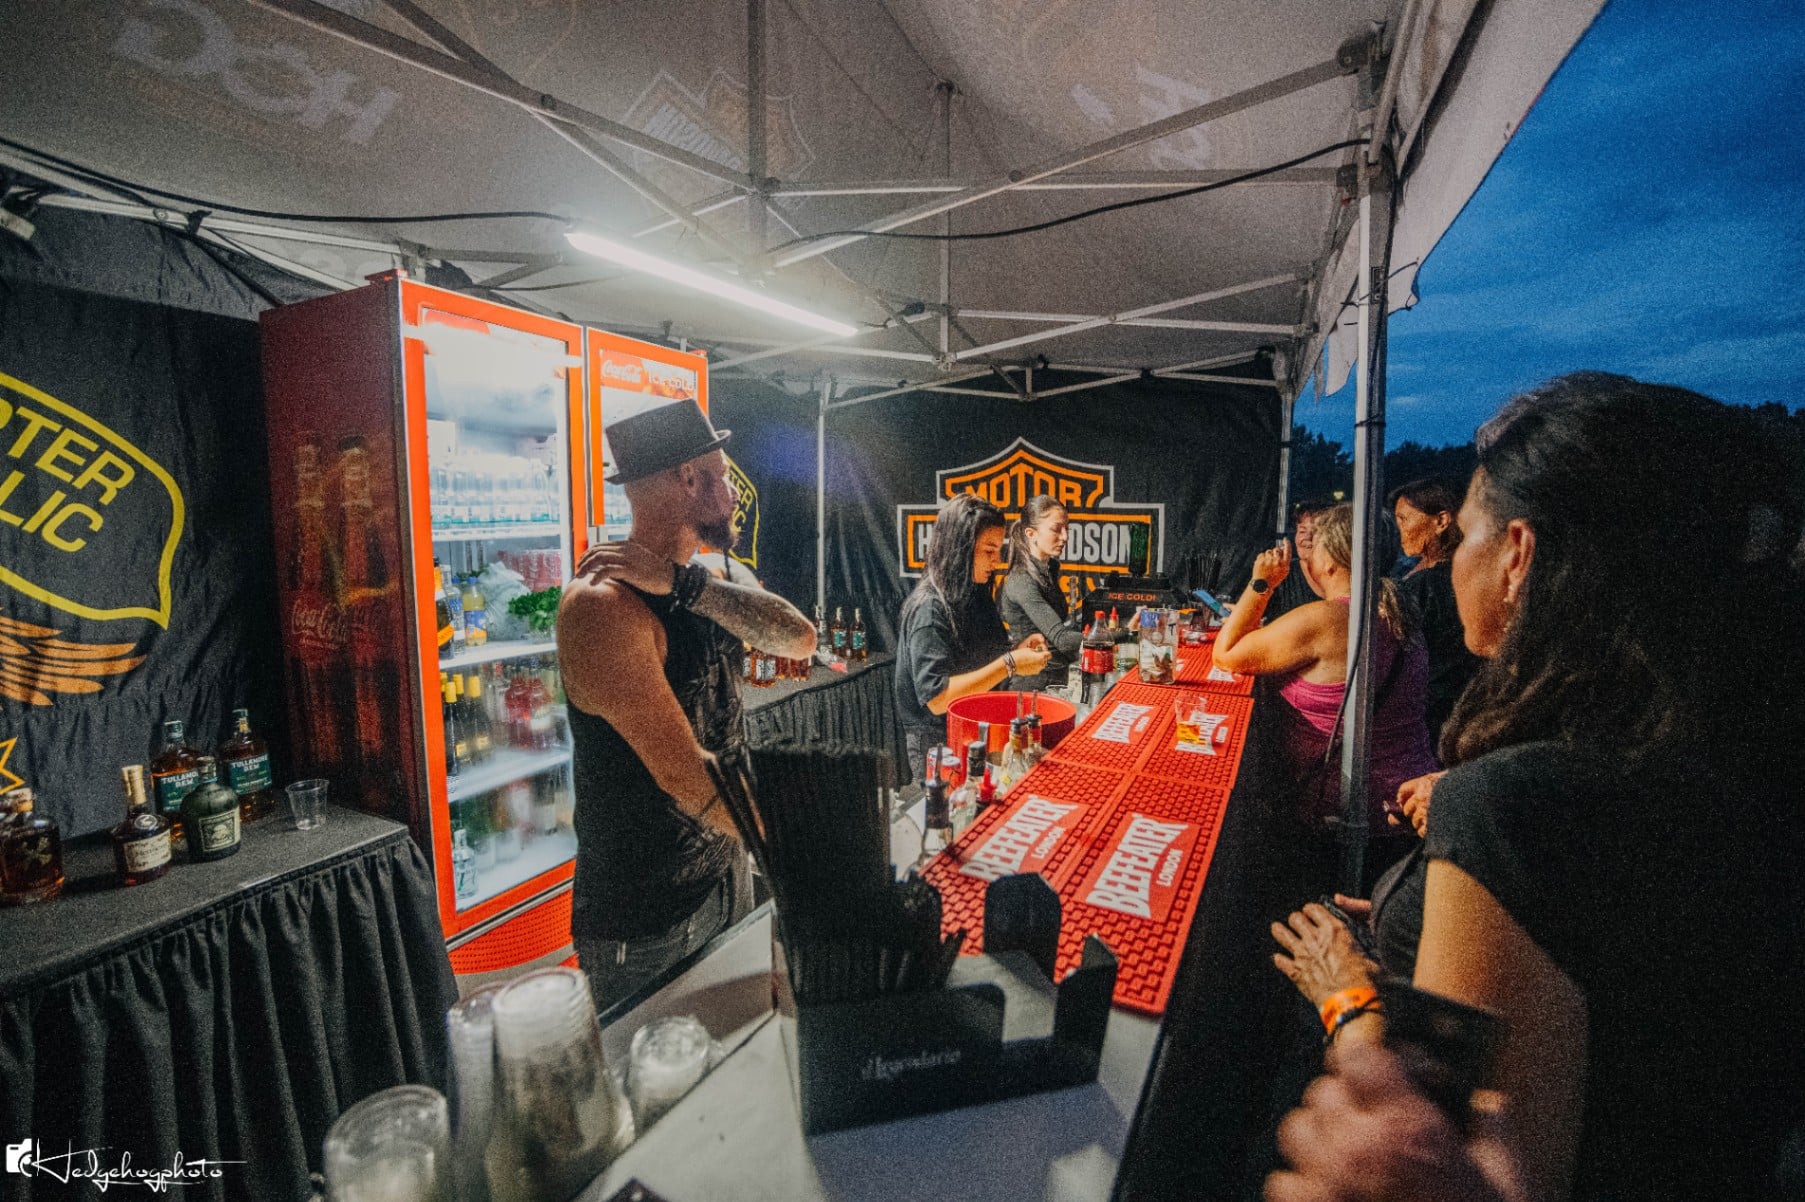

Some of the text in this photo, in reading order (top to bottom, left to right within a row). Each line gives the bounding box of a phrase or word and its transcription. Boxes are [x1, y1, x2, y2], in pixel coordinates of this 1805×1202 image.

[965, 462, 1082, 508] MOTOR
[160, 771, 199, 784] TULLAMO
[959, 797, 1079, 882] BEEFEATER
[1085, 816, 1189, 919] BEEFEATER
[1156, 847, 1184, 887] LONDON
